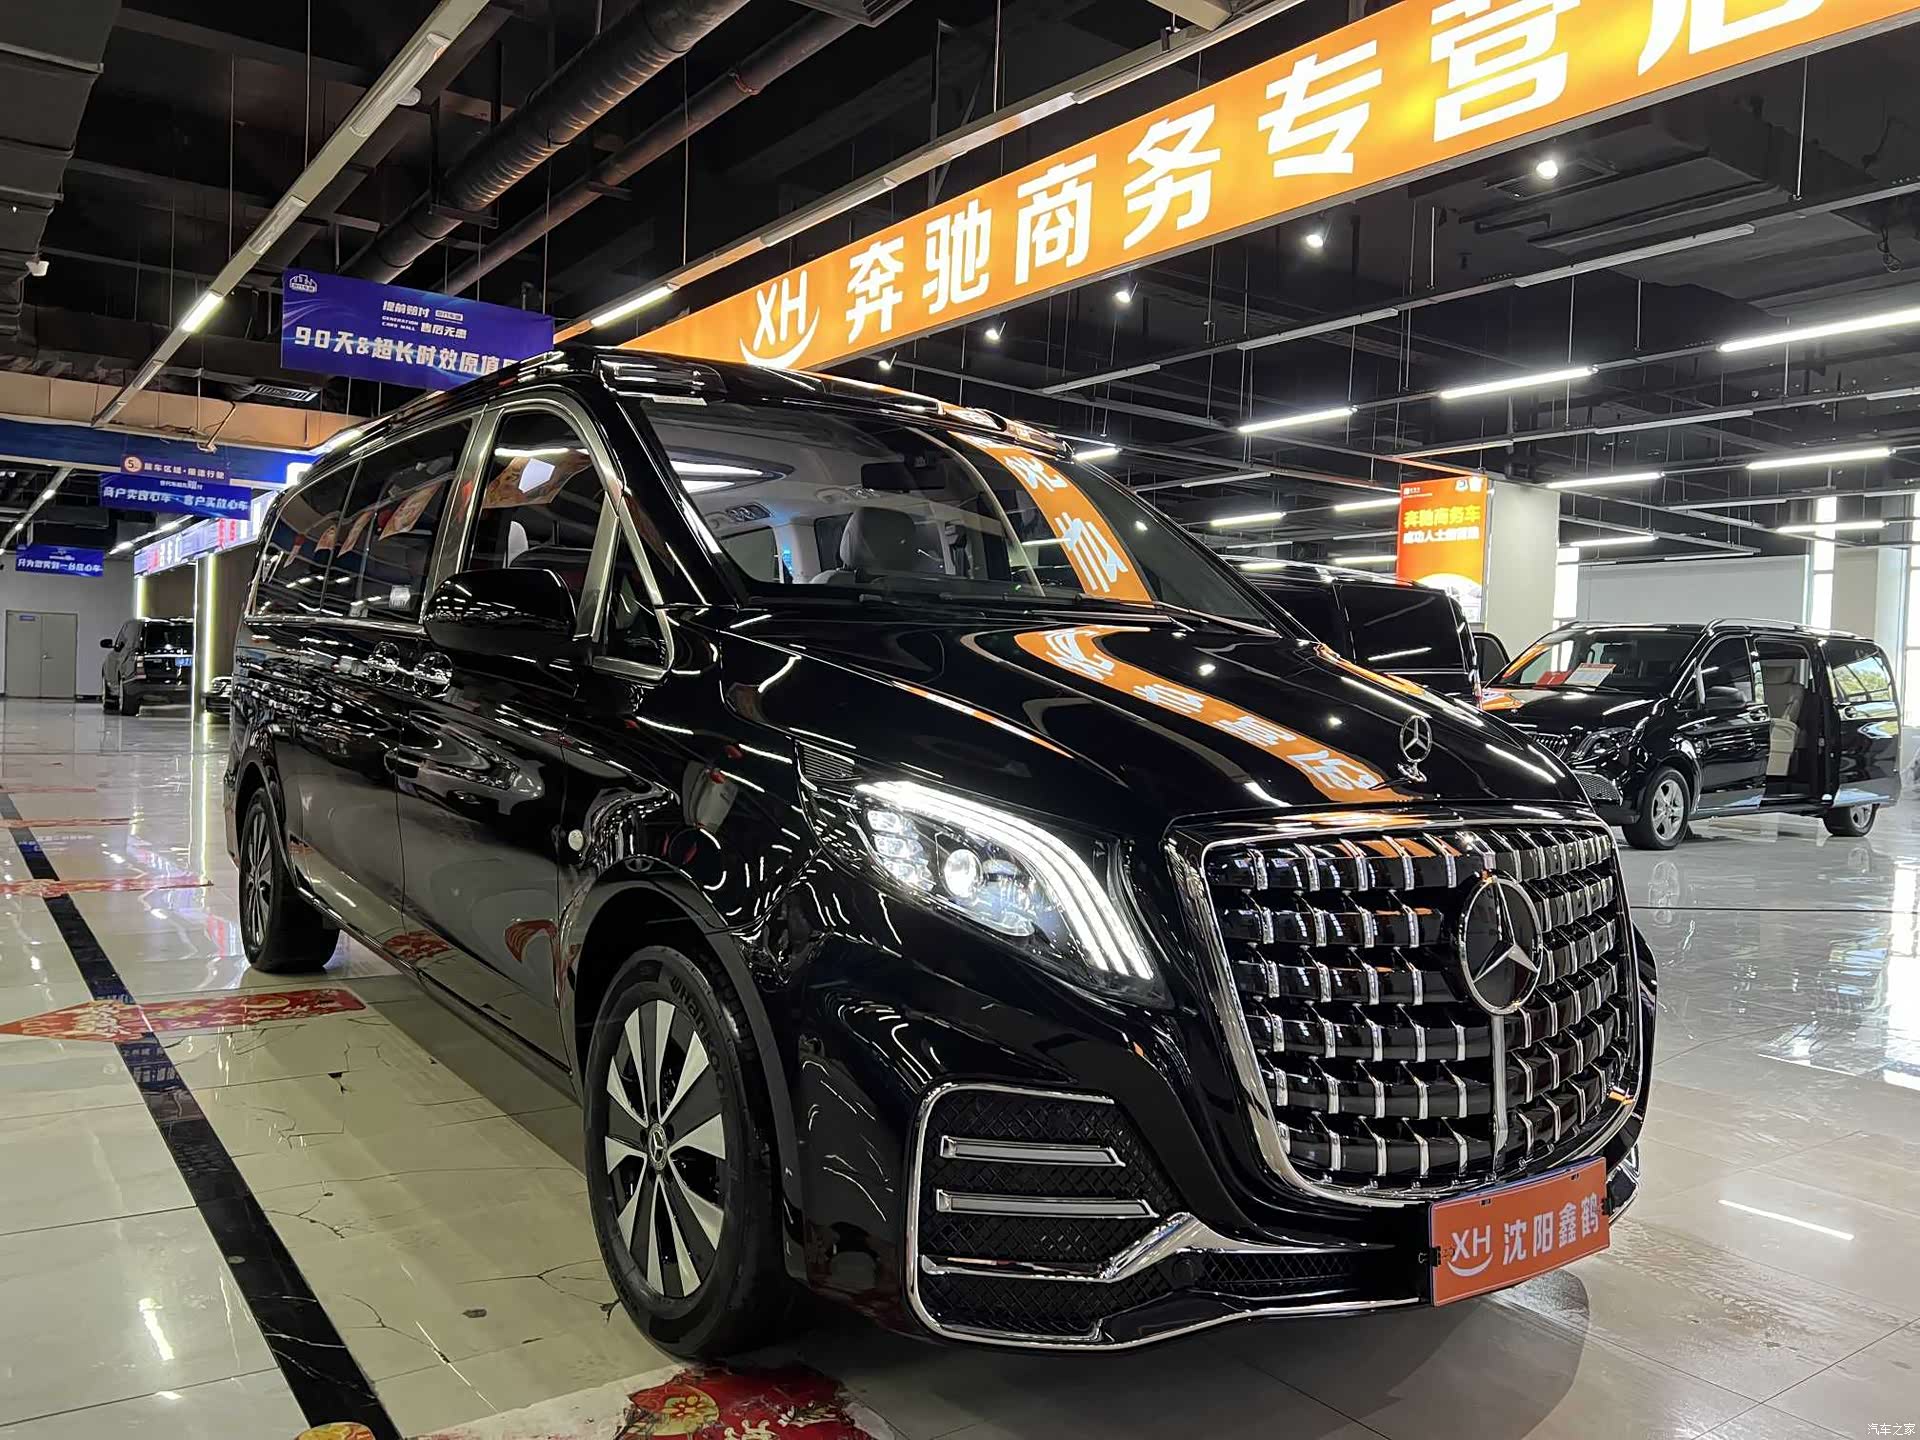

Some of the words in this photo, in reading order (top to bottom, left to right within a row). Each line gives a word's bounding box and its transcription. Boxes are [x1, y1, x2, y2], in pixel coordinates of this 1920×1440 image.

[381, 315, 419, 326] GENERATION
[382, 300, 431, 318] 提前赔付
[753, 269, 808, 352] XH
[1451, 1224, 1491, 1263] XH
[1503, 1192, 1600, 1266] 沈阳鑫鹤
